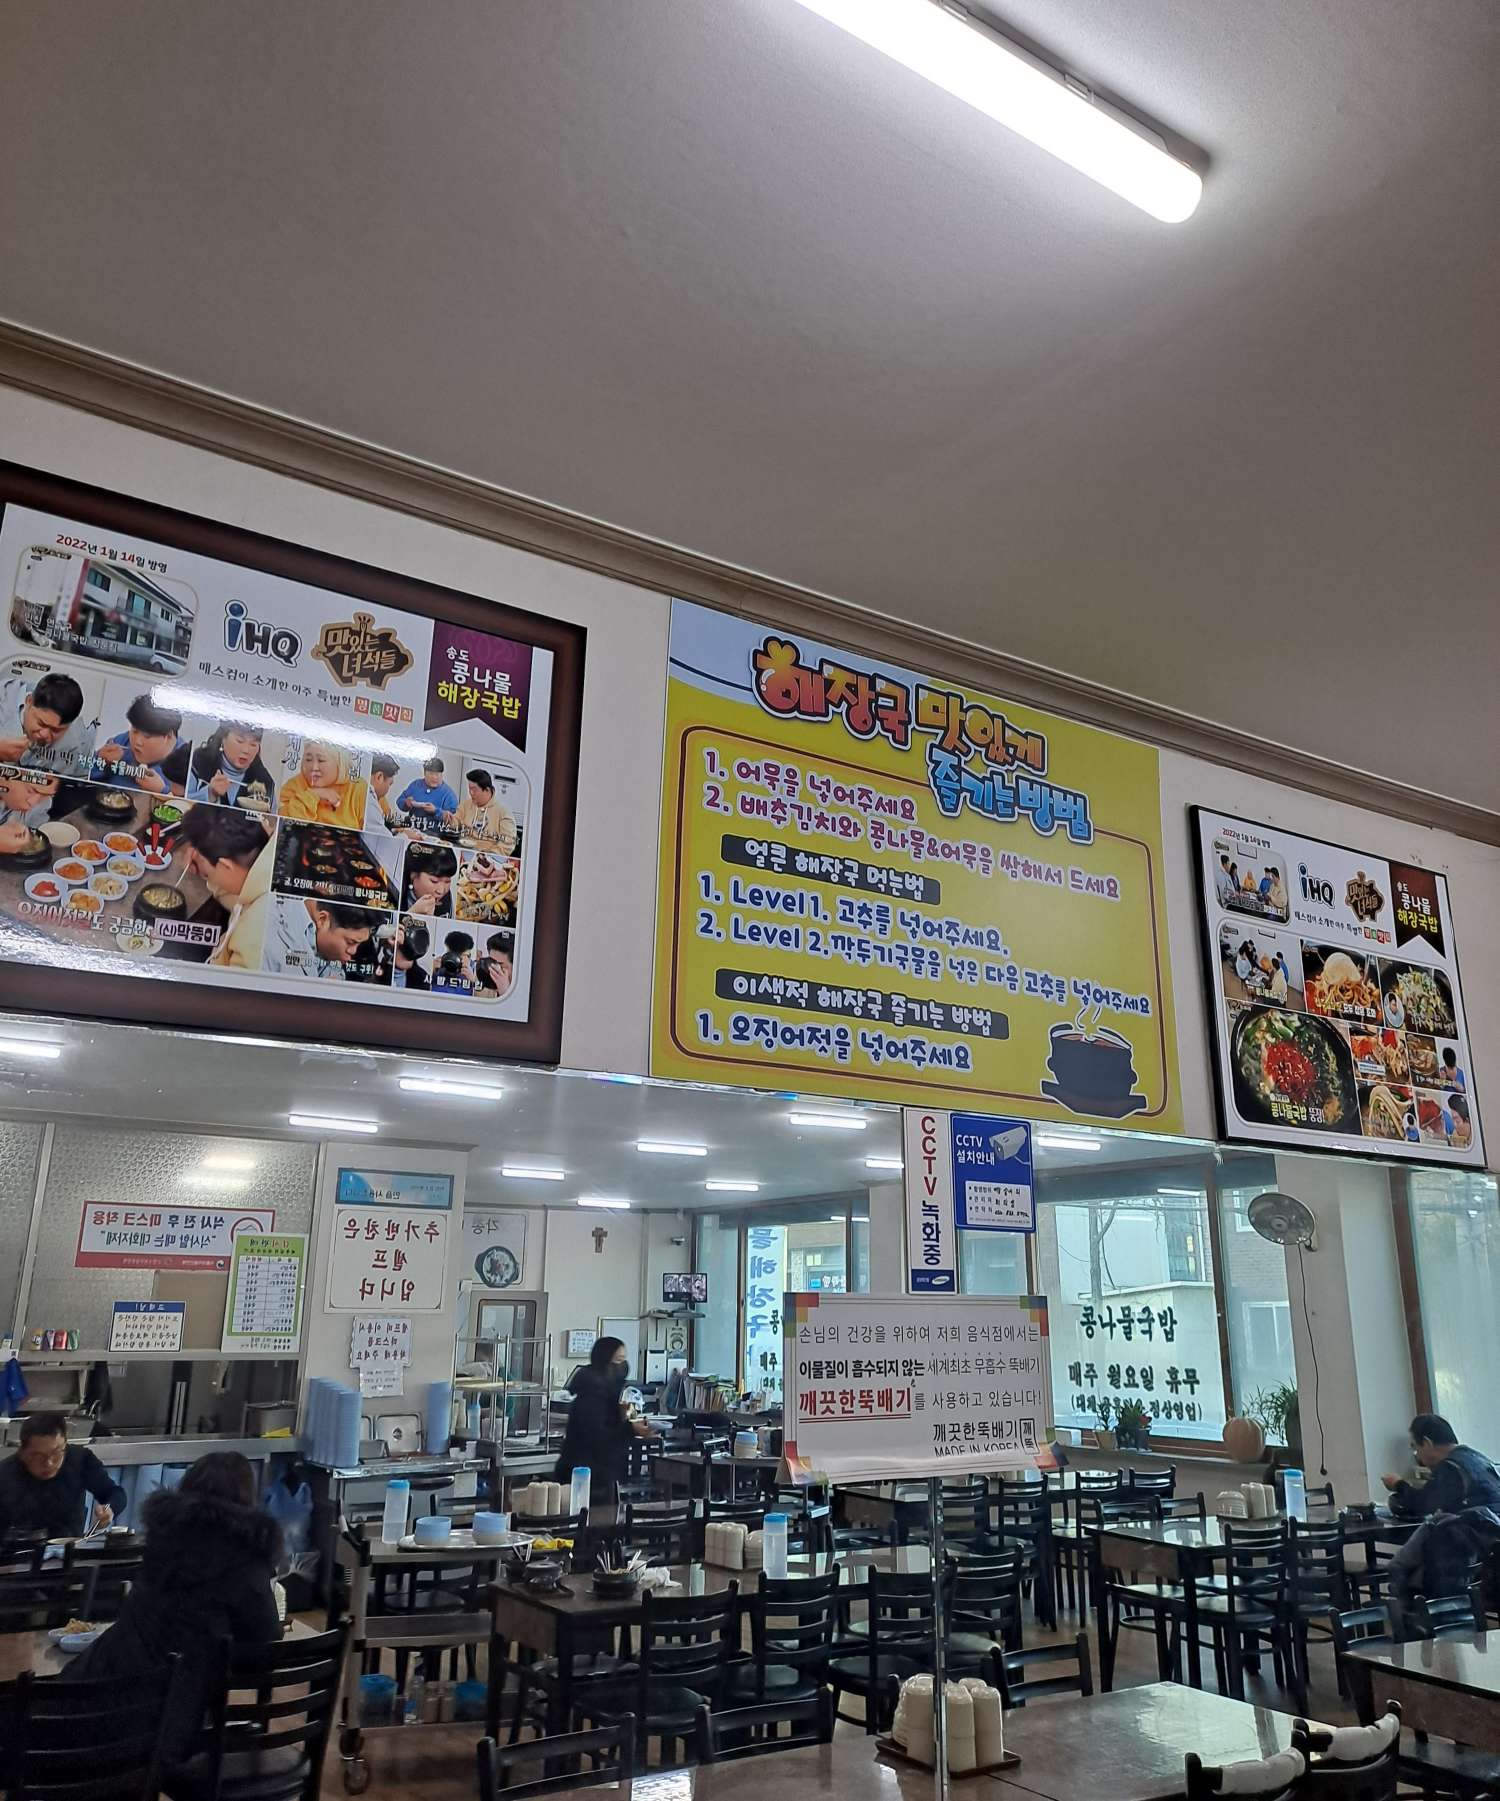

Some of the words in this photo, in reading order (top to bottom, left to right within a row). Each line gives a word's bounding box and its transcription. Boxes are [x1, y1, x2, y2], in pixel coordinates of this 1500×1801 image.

[56, 534, 98, 555] 2022년
[120, 551, 145, 568] 14일
[225, 600, 302, 668] iHQ
[326, 620, 381, 655] 맛있는
[341, 650, 398, 679] 녀석들
[446, 645, 470, 662] 송도
[199, 662, 249, 683] 매스컴이
[252, 675, 289, 692] 소개한
[316, 688, 351, 708] 특별한
[451, 660, 512, 695] 콩나물
[437, 680, 522, 720] 해장국밥
[752, 635, 912, 751] 해장국
[915, 684, 1047, 776] 맛있게
[705, 750, 726, 778] 1.
[736, 760, 800, 798] 어묵을
[808, 774, 916, 821] 넣어주세요
[705, 784, 730, 813] 2.
[740, 794, 862, 838] 배추김치와
[869, 819, 993, 875] 콩나물&어묵을
[1000, 852, 1064, 886] 쌈해서
[1070, 869, 1120, 900] 드세요
[744, 838, 788, 873] 얼큰
[794, 851, 860, 888] 해장국
[866, 866, 925, 901] 먹는법
[1298, 863, 1335, 909] iHQ
[700, 874, 722, 902] 1.
[838, 898, 891, 937] 고추를
[899, 910, 1009, 956] 넣어주세요.
[1396, 907, 1438, 934] 해장국밥
[1402, 893, 1431, 915] 콩나물
[108, 914, 148, 937] 궁금한
[699, 911, 723, 939] 2.
[732, 916, 800, 949] Level
[949, 956, 979, 984] 넣은
[984, 963, 1020, 992] 다음
[1023, 970, 1067, 1004] 고추를
[1071, 979, 1151, 1016] 넣어주세요
[732, 974, 809, 1008] 이색적
[816, 985, 882, 1020] 해장국
[890, 995, 944, 1028] 즐기는
[951, 1006, 993, 1037] 방법
[698, 1012, 721, 1042] 1.
[731, 1014, 849, 1061] 오징어젓을
[860, 1030, 971, 1070] 넣어주세요
[1270, 1102, 1307, 1121] 콩나물국밥
[921, 1115, 937, 1196] CCTV
[956, 1134, 983, 1148] CCTV
[956, 1151, 995, 1166] 설치안내
[921, 1200, 941, 1266] 녹화중
[799, 1327, 840, 1344] 손님의
[847, 1326, 886, 1343] 건강을
[893, 1325, 931, 1343] 위하여
[937, 1325, 962, 1343] 저희
[967, 1323, 1039, 1342] 음식점에서는
[1080, 1305, 1178, 1342] 콩나물국밥
[799, 1360, 849, 1380] 이물질이
[851, 1360, 900, 1379] 흡수되지
[901, 1358, 926, 1378] 않는
[928, 1357, 973, 1376] 세계최초
[974, 1358, 1007, 1375] 무흡수
[1009, 1356, 1041, 1374] 뚝배기
[1068, 1361, 1098, 1388] 매주
[1107, 1363, 1155, 1392] 월요일
[1165, 1366, 1200, 1395] 휴무
[932, 1390, 983, 1409] 사용하고
[988, 1388, 1042, 1408] 있습니다!
[1149, 1400, 1202, 1422] 정상영업)
[932, 1419, 1018, 1443] 깨끗한뚝배기
